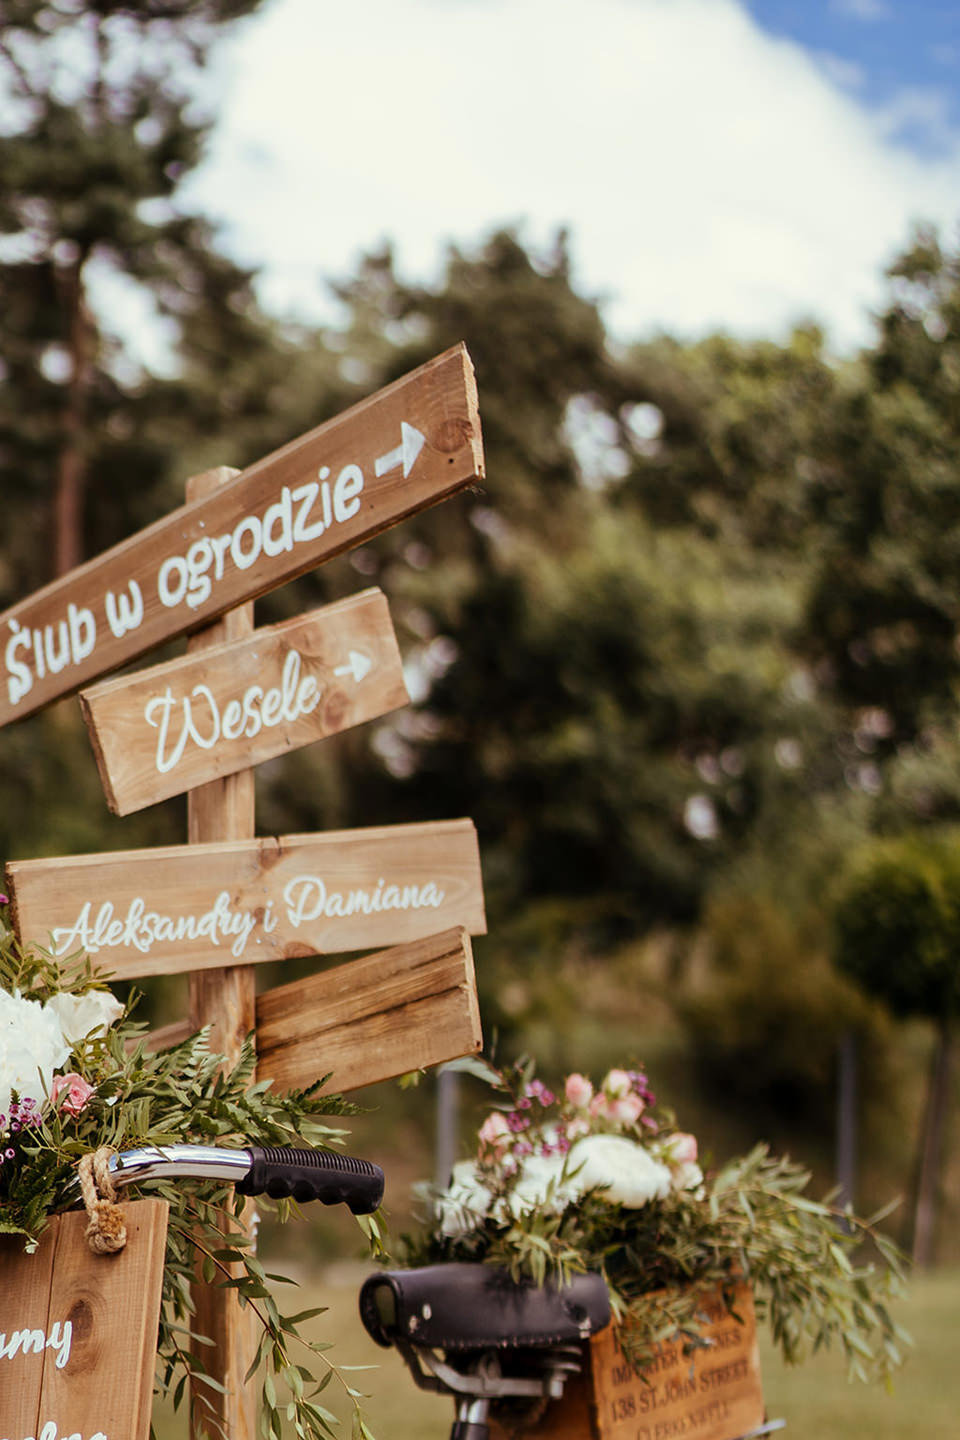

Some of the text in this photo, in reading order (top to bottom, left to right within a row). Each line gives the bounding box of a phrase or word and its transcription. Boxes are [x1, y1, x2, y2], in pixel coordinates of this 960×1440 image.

[4, 464, 365, 705] Ślub w ogrodzie
[144, 648, 321, 774] Wesele
[49, 874, 446, 958] Aleksandry i Damiana
[611, 1393, 637, 1422] 138
[699, 1356, 749, 1392] STREET
